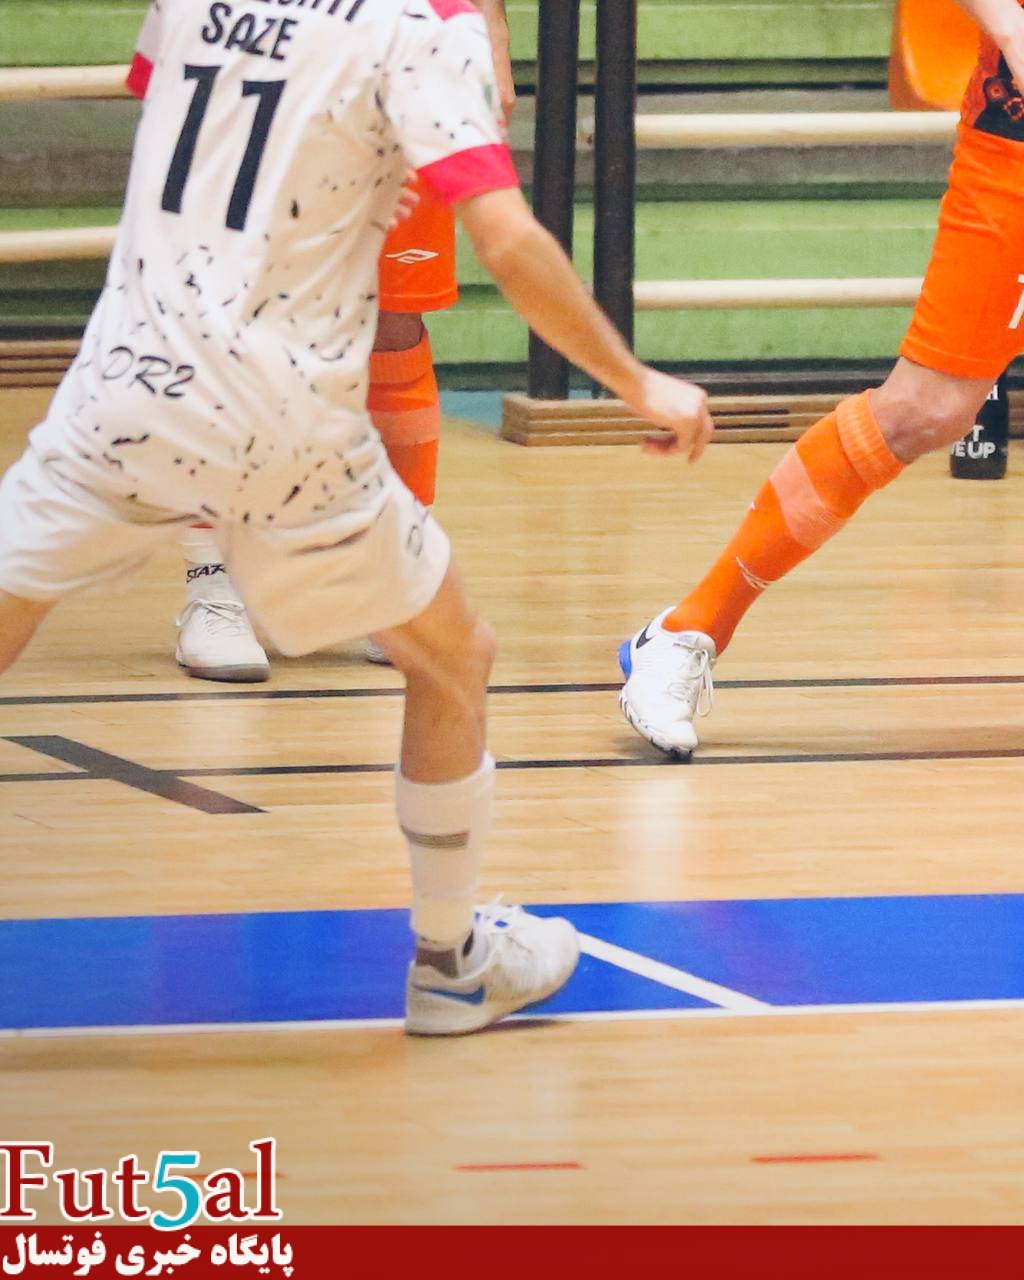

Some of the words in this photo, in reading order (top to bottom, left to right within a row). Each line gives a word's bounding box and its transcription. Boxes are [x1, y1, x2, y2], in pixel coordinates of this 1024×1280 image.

[200, 1, 299, 61] SAZE
[160, 63, 288, 232] 11
[967, 441, 996, 459] UP
